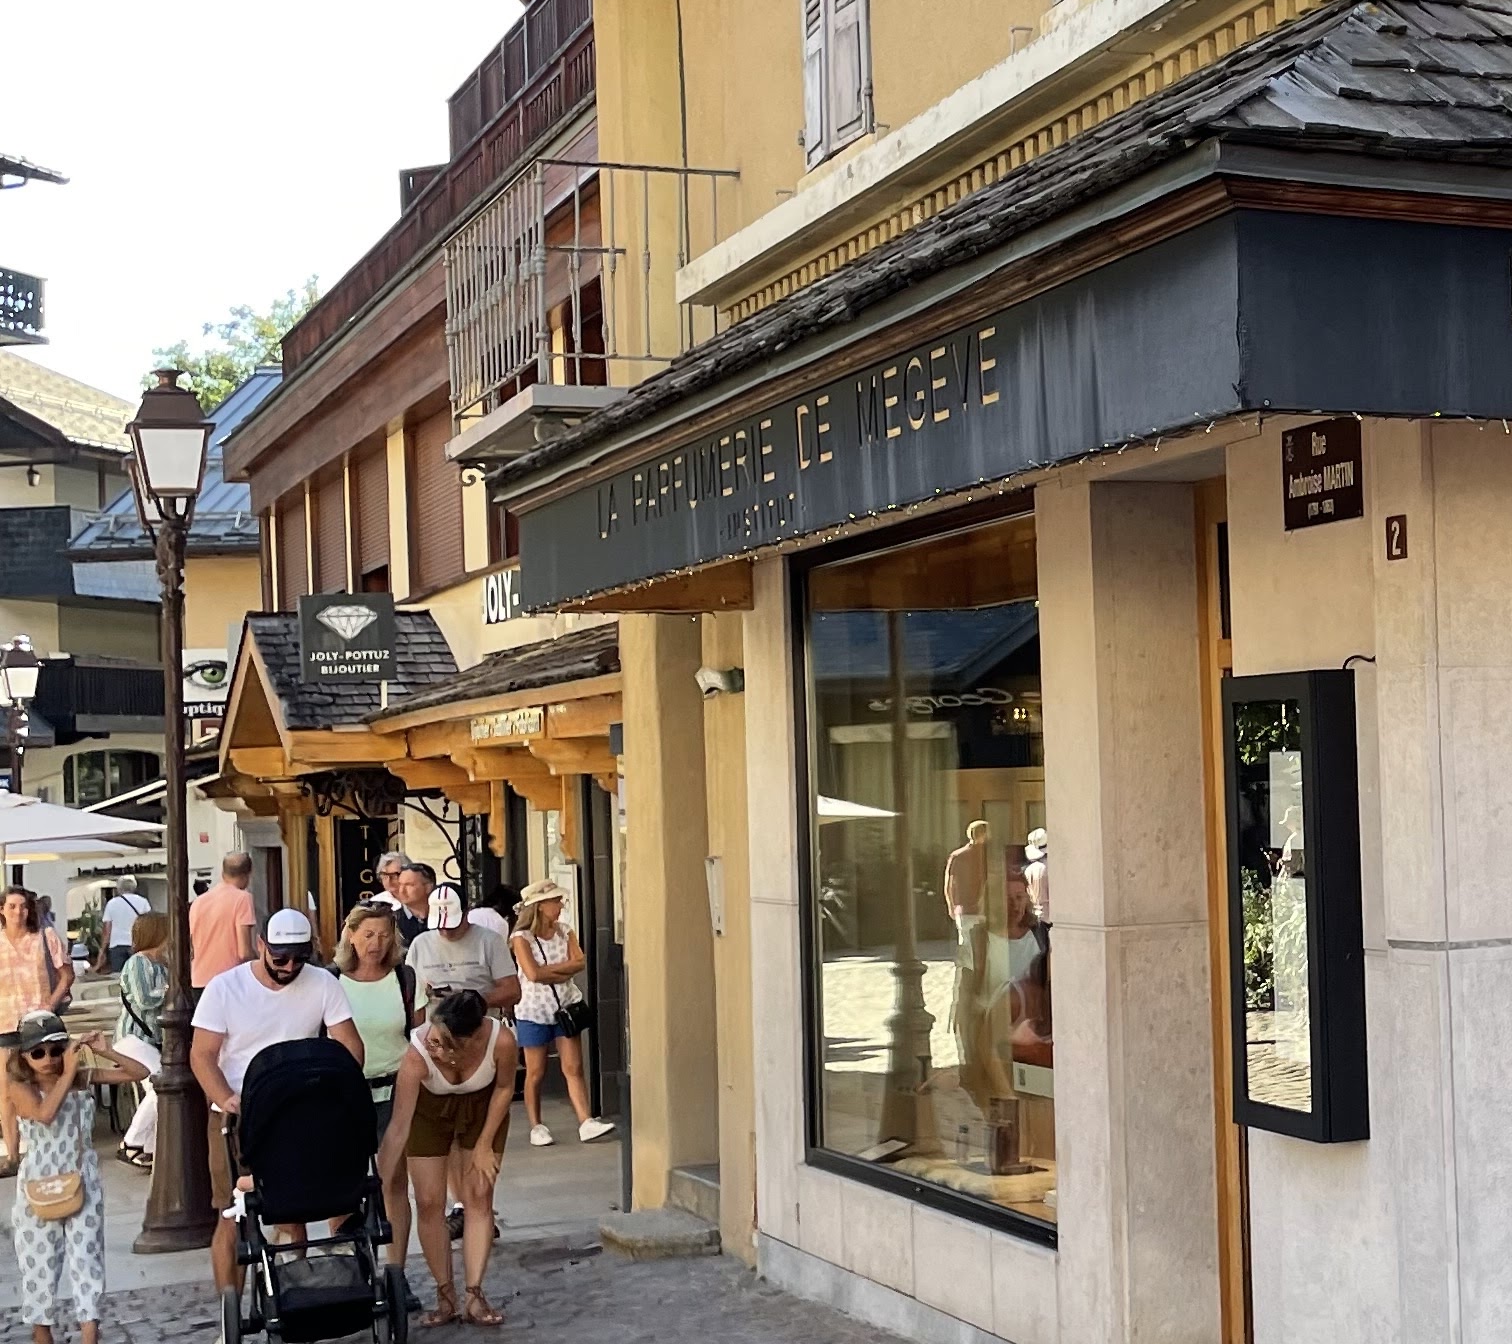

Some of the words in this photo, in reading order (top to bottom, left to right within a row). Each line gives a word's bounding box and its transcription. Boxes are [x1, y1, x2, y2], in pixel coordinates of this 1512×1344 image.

[597, 482, 618, 540] LA
[631, 418, 776, 527] PARFUMERIE
[795, 394, 833, 471] DE
[856, 326, 1001, 450] MEGEVE
[1323, 460, 1355, 492] MARTIN
[1391, 520, 1402, 556] 2
[320, 664, 380, 675] BIJOUTIER
[183, 702, 226, 717] ptiq
